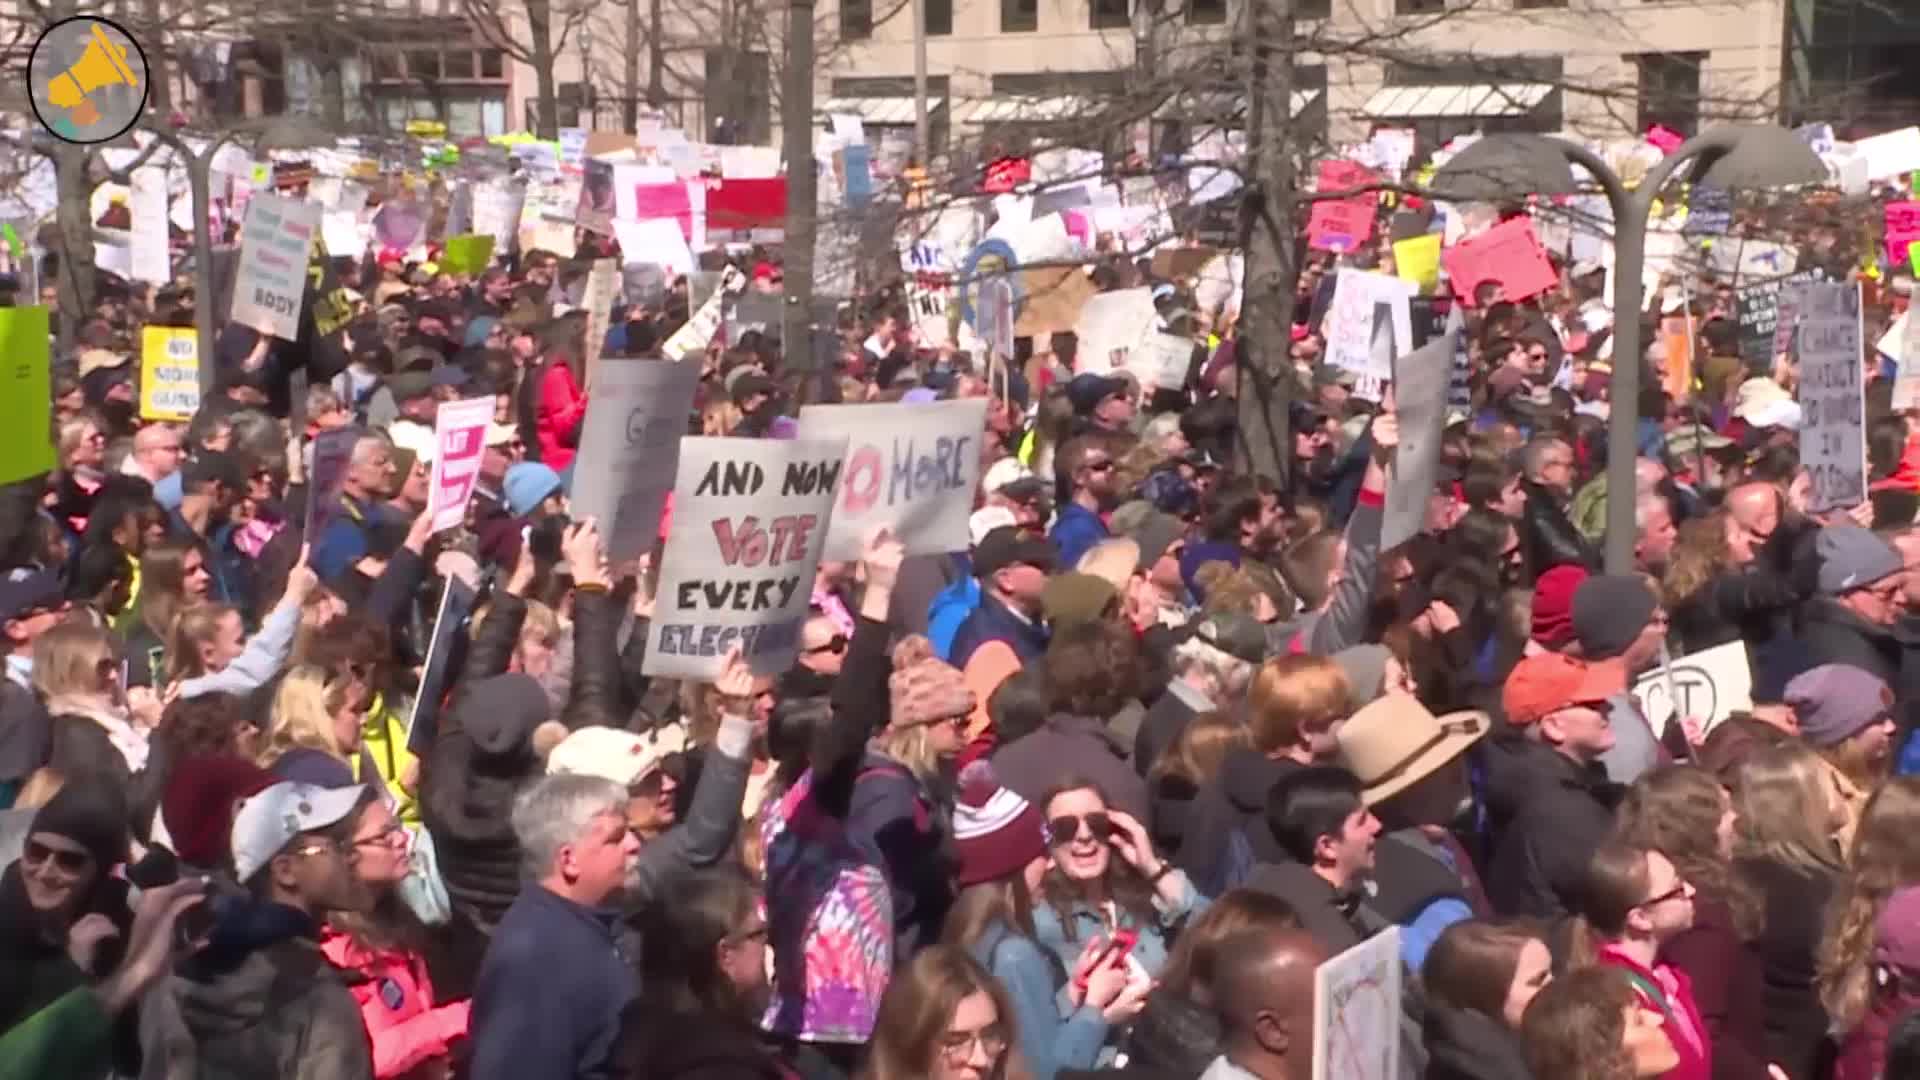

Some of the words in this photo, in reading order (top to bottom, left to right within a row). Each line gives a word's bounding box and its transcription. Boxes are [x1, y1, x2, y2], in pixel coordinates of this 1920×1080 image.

[253, 287, 297, 317] BODY
[694, 460, 763, 496] AND
[781, 458, 841, 495] NOW
[711, 513, 816, 567] VOTE
[676, 576, 800, 610] EVERY
